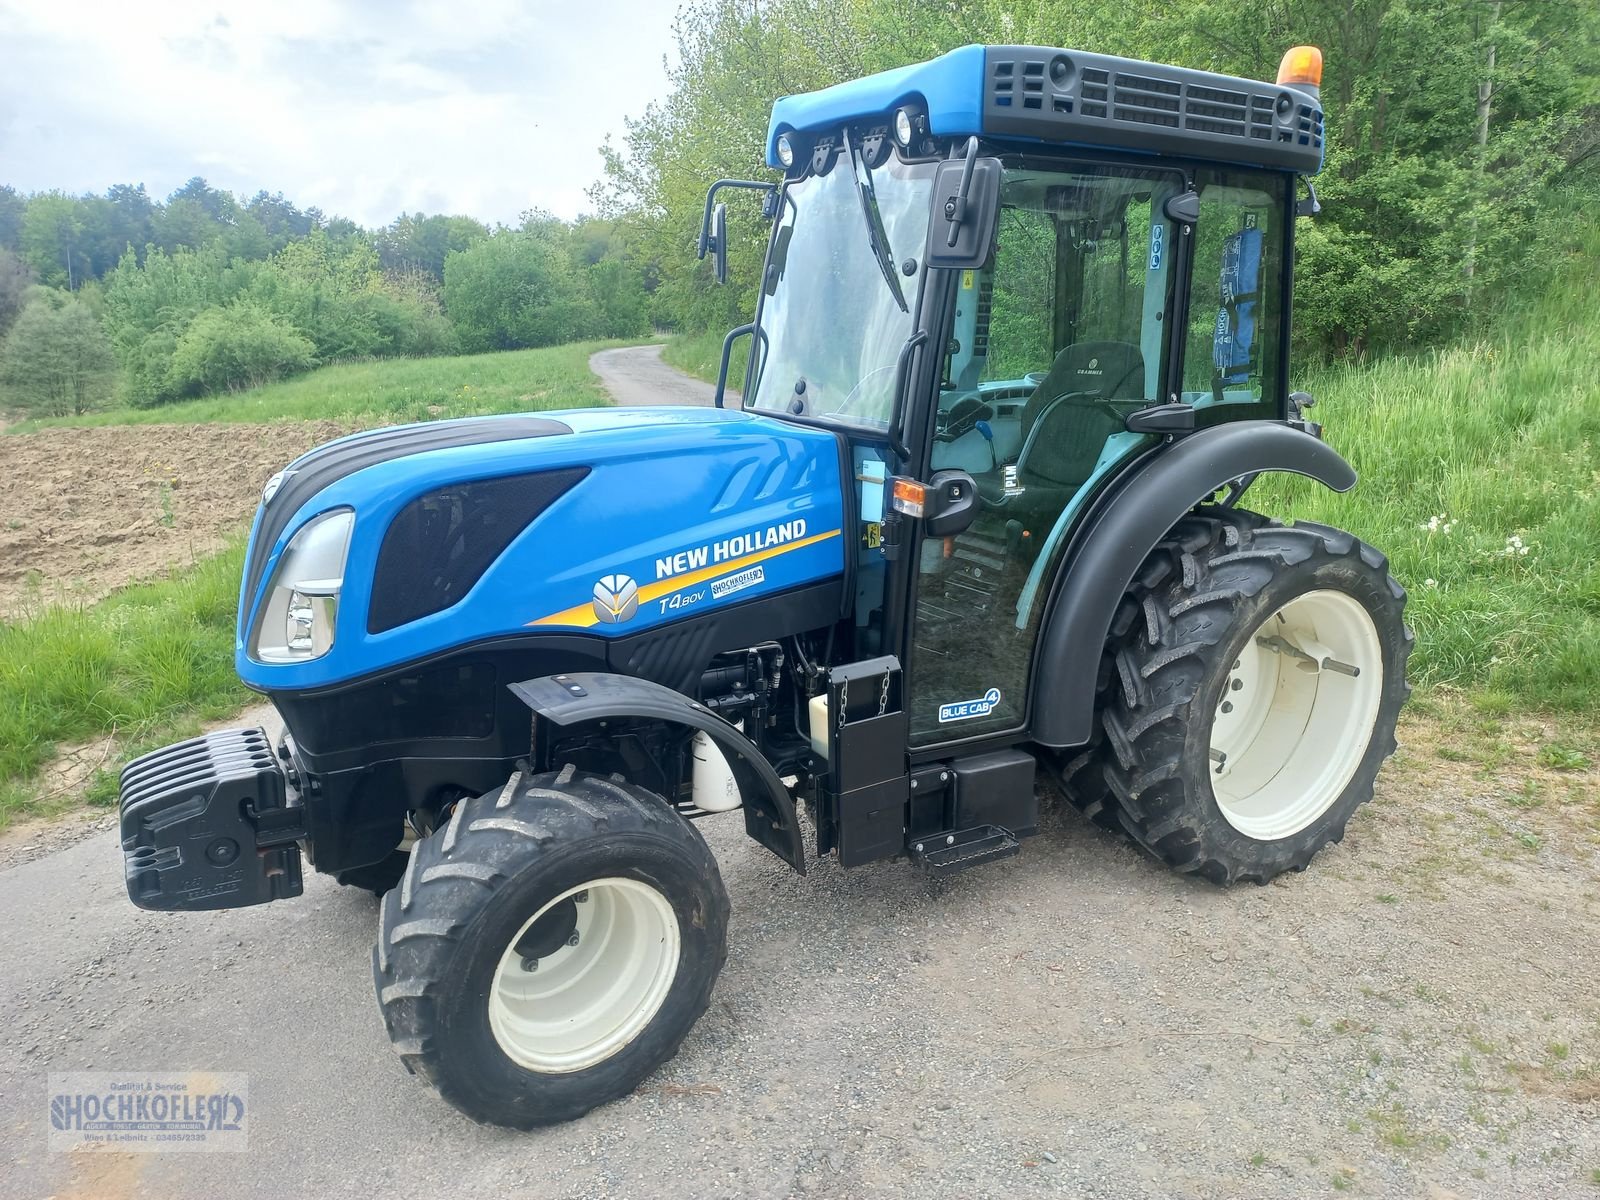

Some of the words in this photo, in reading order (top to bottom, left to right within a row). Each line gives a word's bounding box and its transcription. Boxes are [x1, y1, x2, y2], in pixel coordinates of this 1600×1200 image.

[1005, 465, 1017, 487] PLM
[655, 545, 709, 579] NEW
[713, 518, 807, 562] HOLLAND
[942, 705, 968, 718] BLUE
[969, 702, 990, 713] CAB
